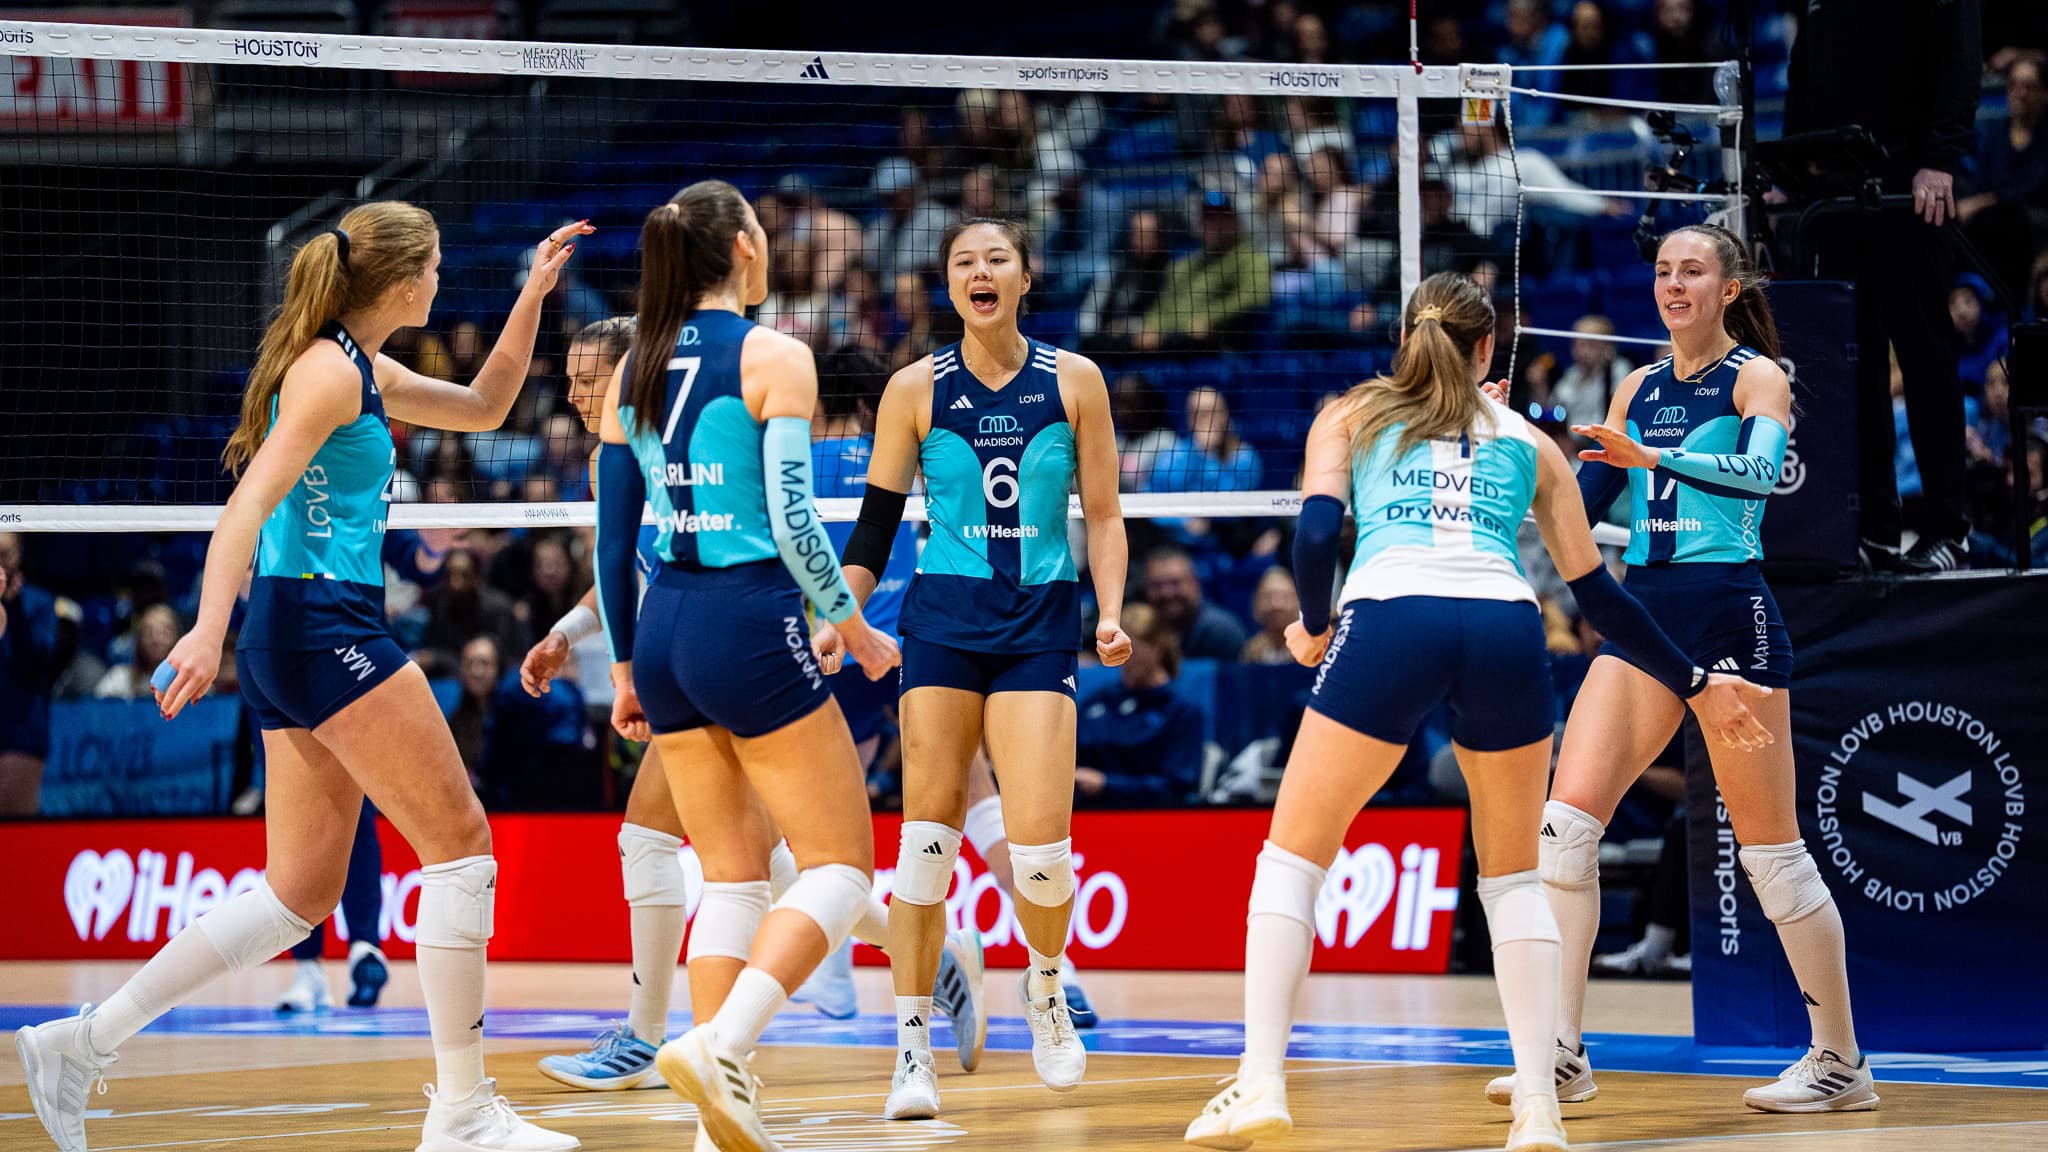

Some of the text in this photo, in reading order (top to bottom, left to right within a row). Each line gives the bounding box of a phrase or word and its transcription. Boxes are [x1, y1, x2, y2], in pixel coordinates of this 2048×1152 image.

[0, 29, 34, 43] orts
[235, 38, 318, 57] HOUSTON
[523, 47, 585, 60] MEMORIAL
[523, 57, 585, 70] HERMANN
[1269, 72, 1339, 87] HOUSTON
[661, 356, 702, 445] 7
[1019, 394, 1045, 404] LOVB
[1694, 387, 1720, 396] LOVB
[974, 437, 1023, 447] MADISON
[1643, 428, 1685, 437] MADISON
[1712, 452, 1775, 481] LOVB
[982, 457, 1020, 508] 6
[1393, 469, 1499, 499] MEDVED
[303, 464, 332, 538] LOVB
[0, 513, 22, 523] orts
[780, 461, 840, 592] MADISON
[1386, 505, 1502, 534] DryWater
[1750, 596, 1770, 670] MADISON
[1312, 609, 1354, 695] MADISON
[1816, 701, 2025, 913] LOVB HOUSTON LOVB HOUSTON LOVB HOUSTON
[1940, 832, 1963, 846] VB
